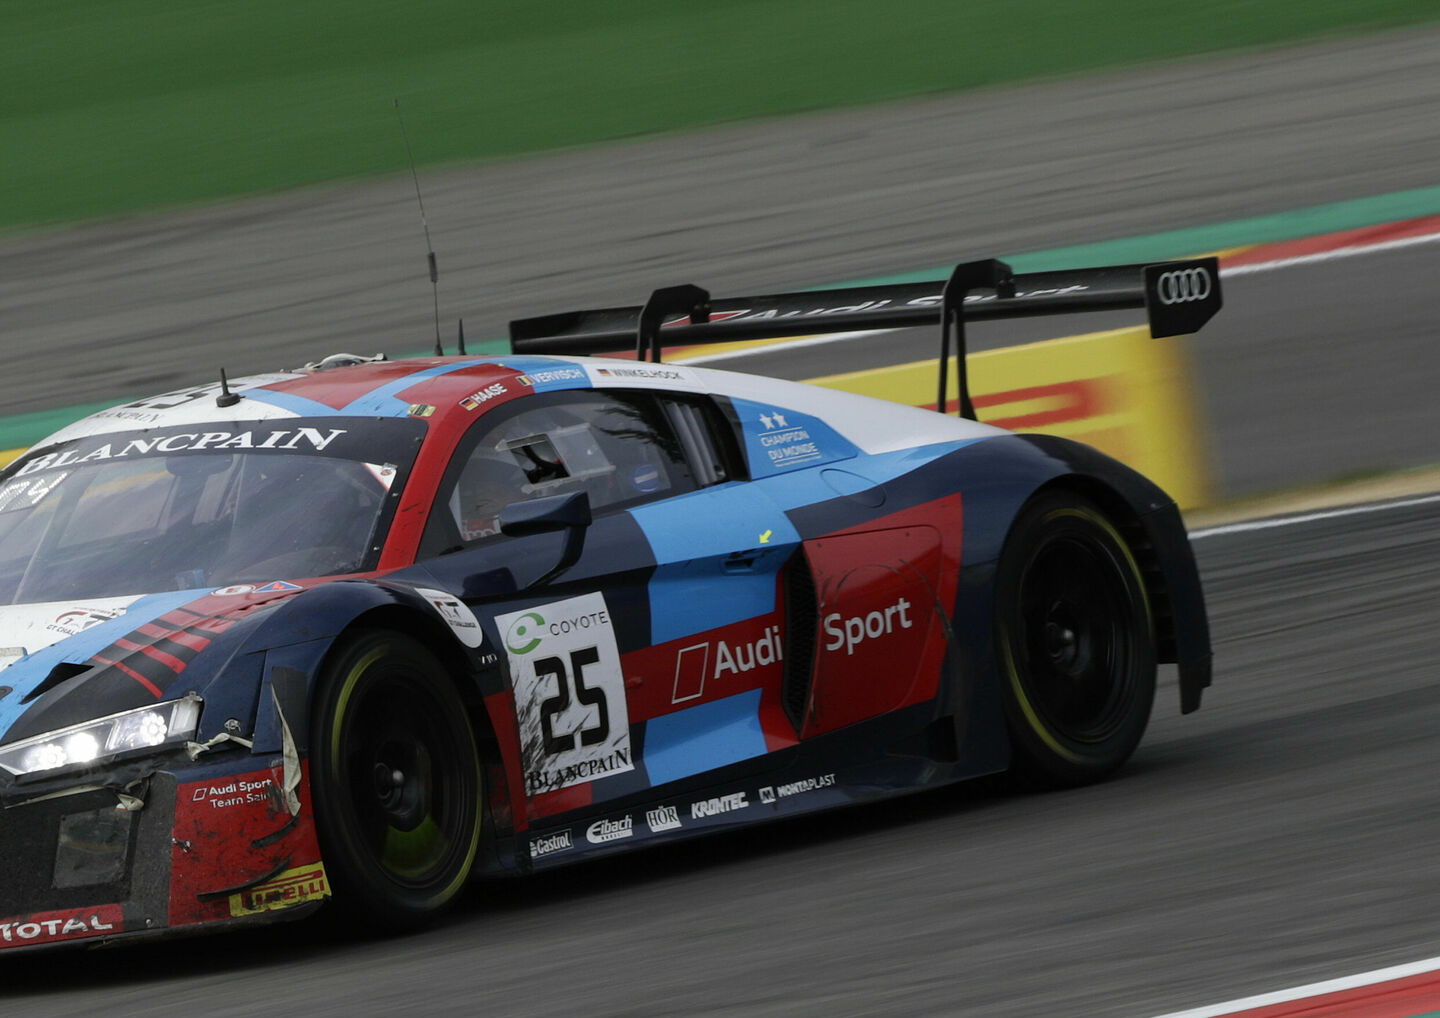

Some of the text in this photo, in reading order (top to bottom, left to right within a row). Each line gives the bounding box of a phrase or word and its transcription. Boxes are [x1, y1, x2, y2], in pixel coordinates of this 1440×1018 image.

[905, 284, 1090, 306] Sprt
[531, 368, 585, 384] VERVISCH
[612, 367, 684, 380] WINKELHOCK
[470, 382, 508, 404] HAASE
[760, 430, 810, 447] CHAMPION
[13, 427, 348, 477] BLANCPAIN
[768, 442, 819, 460] DU MONDE
[549, 611, 609, 636] COYOTE
[714, 598, 912, 680] Audi Sport
[533, 645, 610, 756] 25
[528, 748, 630, 792] BLANCPAIN
[209, 778, 273, 796] Audi Sport
[776, 773, 836, 798] MONTAPLAST
[210, 794, 244, 809] Team
[648, 805, 678, 827] HÖR
[586, 813, 633, 844] Eibach
[536, 832, 572, 855] Castrol
